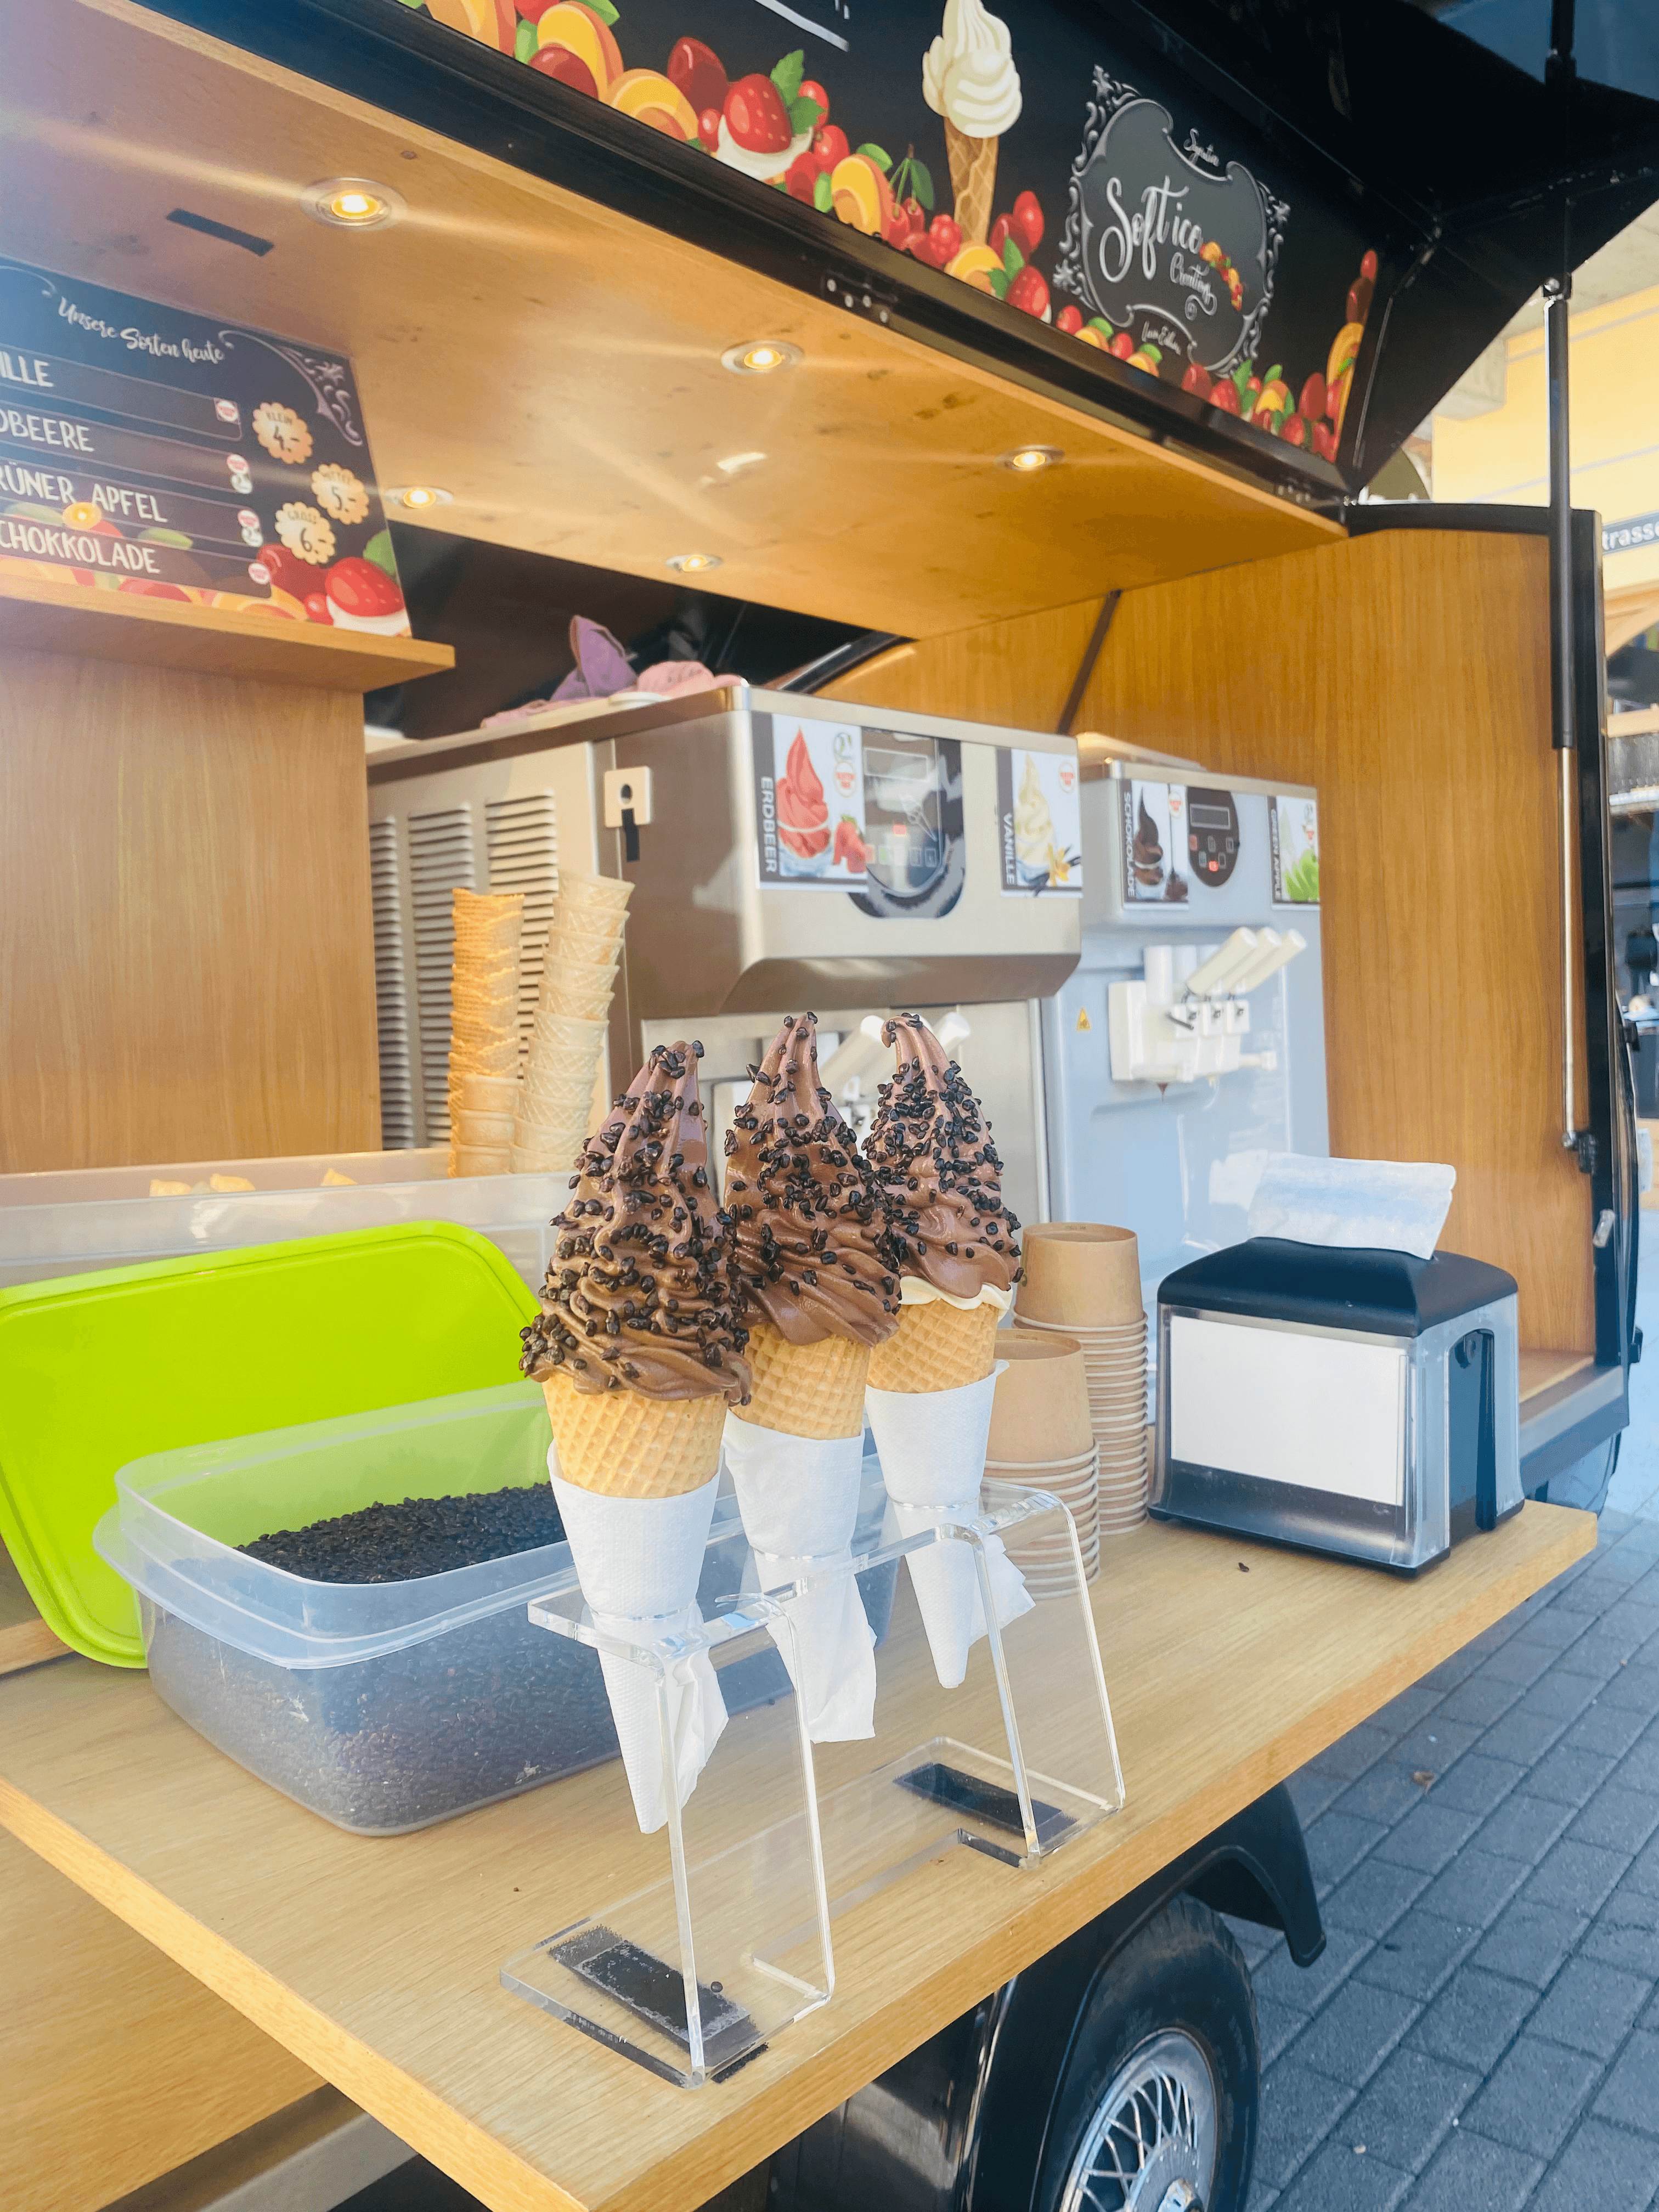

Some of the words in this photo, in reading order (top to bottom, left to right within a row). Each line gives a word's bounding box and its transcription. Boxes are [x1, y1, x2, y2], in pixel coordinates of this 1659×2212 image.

[58, 296, 118, 338] Unsere
[120, 327, 180, 358] Sorten
[182, 337, 225, 364] heute
[92, 483, 168, 523] APFEL
[0, 520, 160, 574] CHOKKOLADE
[761, 776, 777, 873] ERDBEER
[1003, 813, 1015, 884] VANILLE
[1124, 791, 1135, 897] SCHOKOLADE
